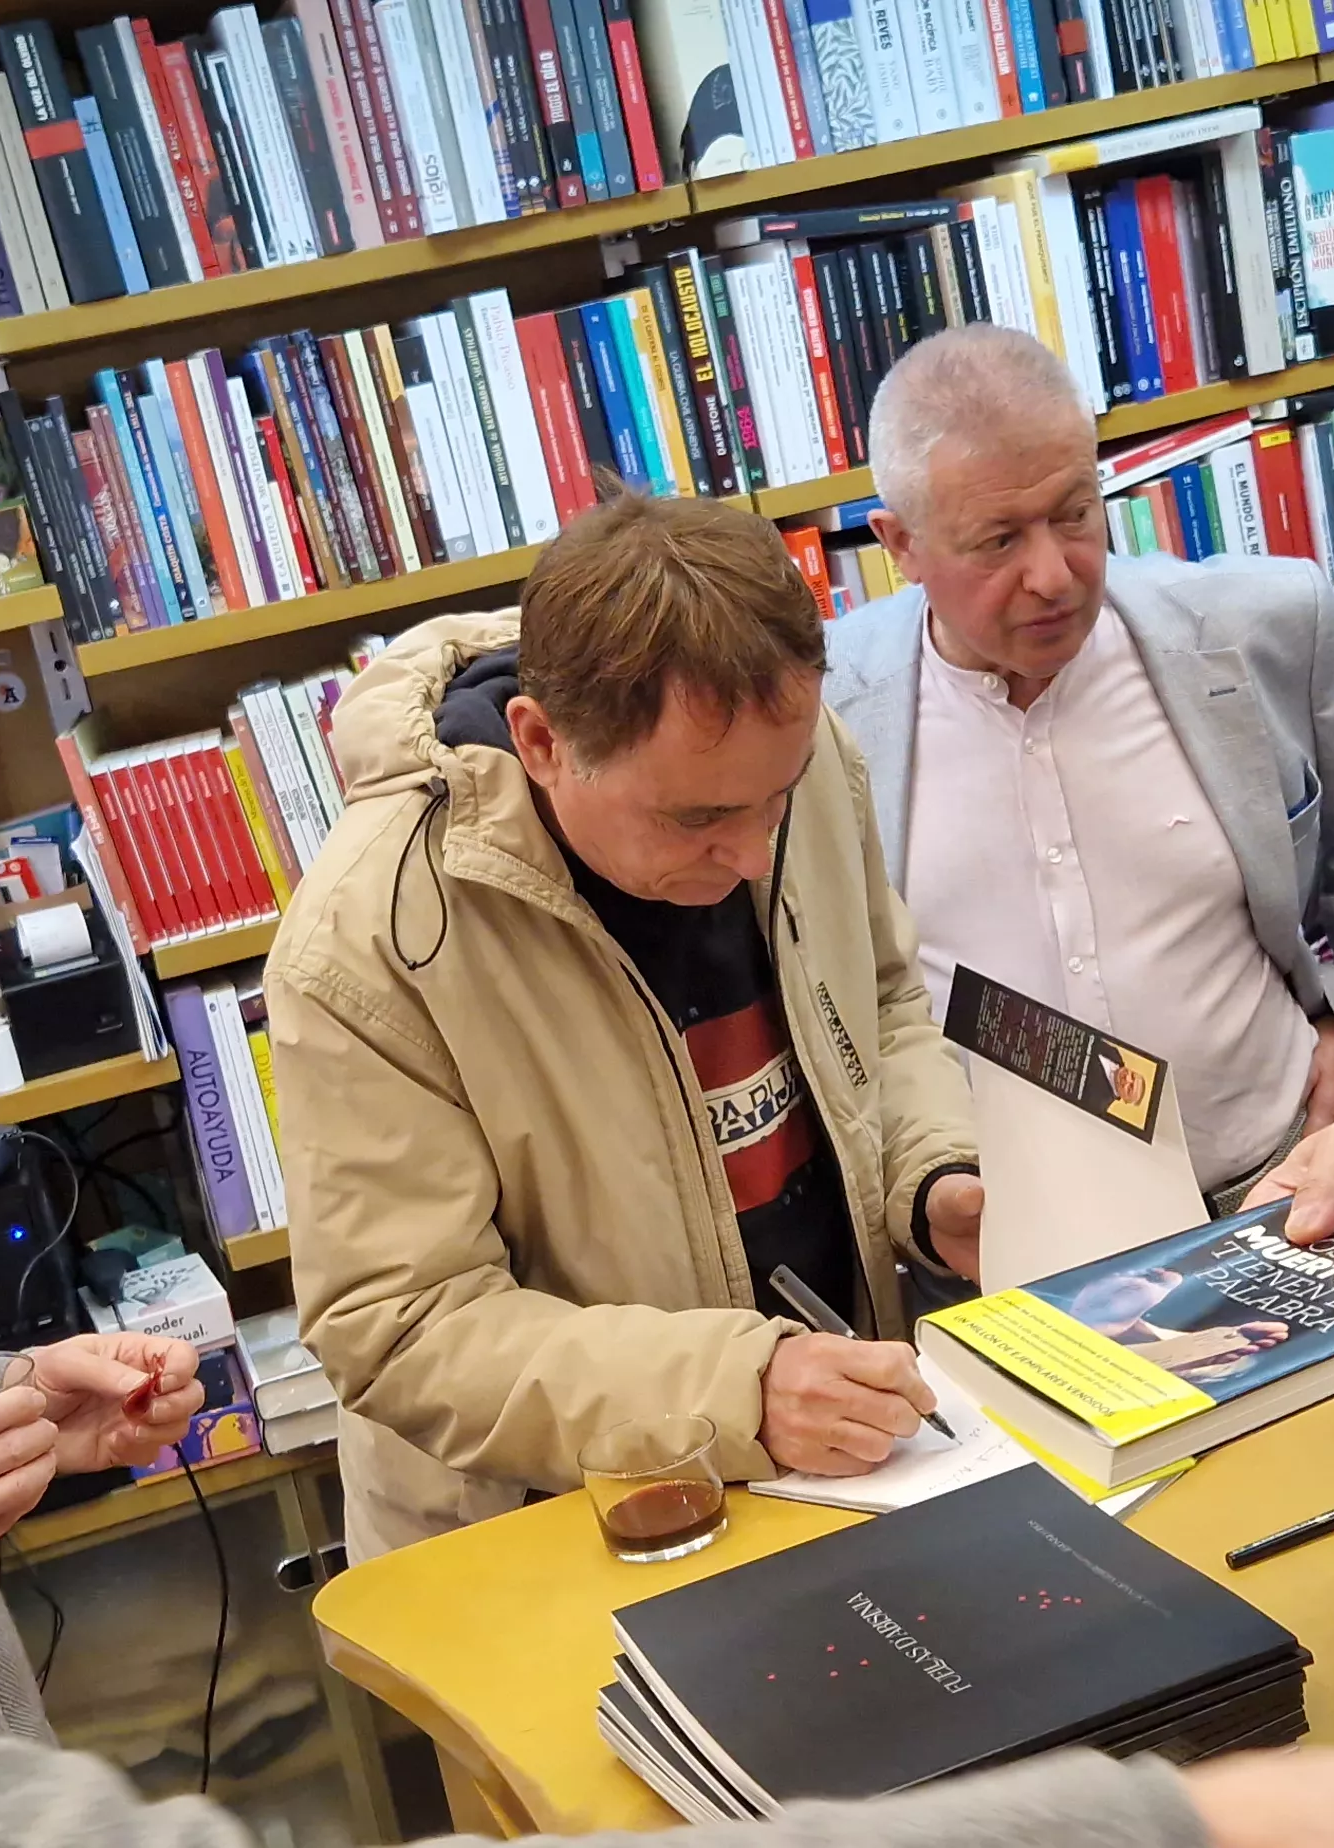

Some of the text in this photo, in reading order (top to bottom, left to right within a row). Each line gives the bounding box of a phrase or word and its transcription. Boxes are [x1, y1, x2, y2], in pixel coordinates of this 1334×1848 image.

[14, 34, 34, 69] OLVIDO
[25, 71, 41, 90] DEL
[30, 90, 47, 108] VOZ
[36, 108, 49, 121] LA
[1279, 176, 1311, 329] ESCIPIÓN EMILIANO
[674, 267, 715, 383] EL HOLOCAUSTO
[489, 305, 516, 391] Pablo Picasso
[705, 395, 727, 456] DAN STONE
[1234, 461, 1246, 479] EL
[1237, 480, 1254, 523] MUNDO
[156, 513, 173, 544] COSTA
[1244, 524, 1257, 541] AL
[186, 1048, 237, 1185] AUTOAYUDA
[1211, 1240, 1326, 1300] TIENEN
[997, 1341, 1013, 1355] DE
[1010, 1350, 1067, 1389] EJEMPLARES
